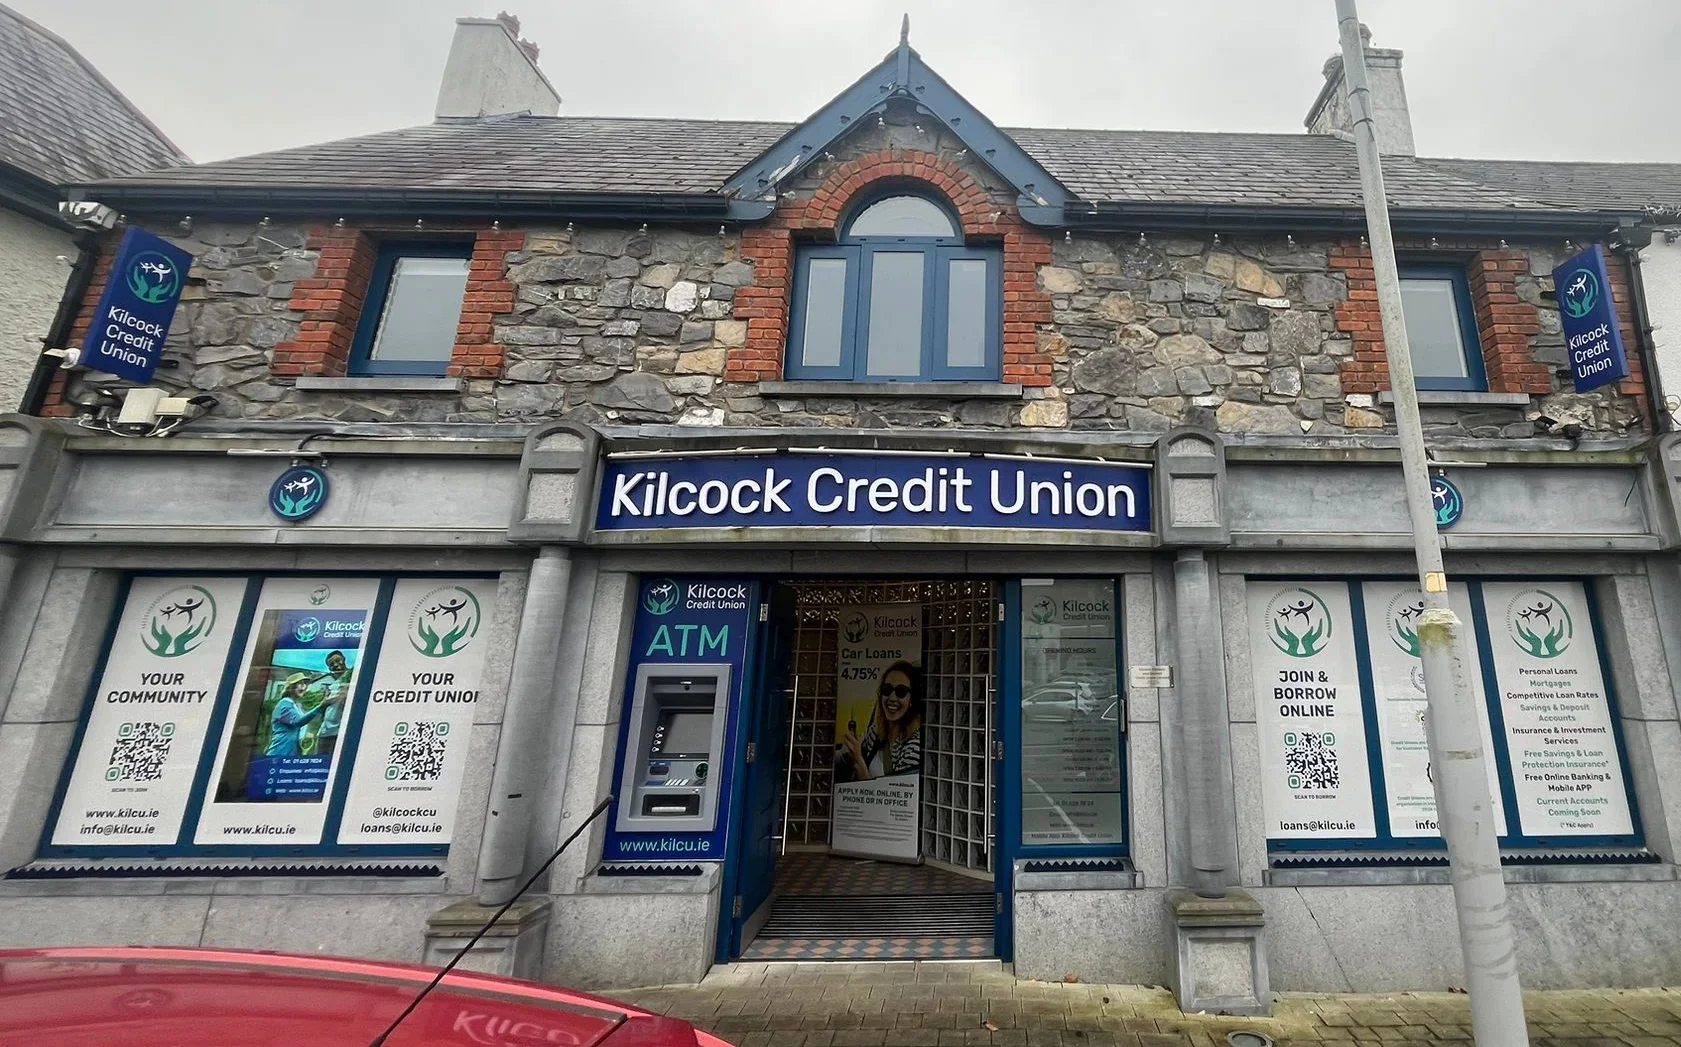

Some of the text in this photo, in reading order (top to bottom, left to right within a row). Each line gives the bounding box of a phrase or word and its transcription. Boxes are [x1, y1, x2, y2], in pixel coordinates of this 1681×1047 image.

[108, 306, 163, 338] Kilcock
[106, 325, 154, 352] Credit
[1569, 323, 1609, 350] Kilcock
[101, 341, 147, 367] Union
[1574, 339, 1610, 363] Credit
[1578, 358, 1612, 378] Union
[610, 467, 1136, 518] Kilcock Credit Union
[687, 584, 746, 599] Kilcock
[686, 600, 746, 609] Credit Union
[1063, 600, 1109, 612] Kilcock
[873, 616, 918, 628] Kilcock
[1063, 613, 1111, 621] Credit Union
[324, 621, 366, 631] Kilcock
[645, 624, 729, 657] ATM
[841, 648, 902, 659] Car Loans
[141, 673, 184, 685] YOUR
[412, 673, 454, 685] YOUR
[1279, 671, 1328, 683] JOIN &
[1529, 680, 1572, 688] Mortgages
[107, 691, 208, 703] COMMUNITY
[373, 690, 432, 703] CREDIT
[1273, 688, 1337, 700] BORROW
[1506, 692, 1555, 700] Competitive
[1279, 705, 1335, 717] ONLINE
[1520, 704, 1551, 712] Savings
[1560, 704, 1590, 712] Deposit
[1538, 714, 1577, 722] Accounts
[1561, 726, 1607, 734] Investment
[1544, 737, 1579, 745] Services
[1543, 750, 1575, 758] Savings
[1544, 773, 1570, 781] Online
[1571, 773, 1604, 782] Banking
[838, 787, 859, 795] APPLY
[1548, 784, 1592, 792] Mobile APP
[842, 796, 865, 804] PHONE
[884, 799, 908, 807] OFFICE
[1536, 797, 1609, 805] Current Accounts
[86, 808, 159, 818] www.kilcu.ie
[372, 807, 437, 818] @kilcockcu
[1548, 808, 1601, 817] Coming Soon
[80, 824, 155, 835] info@kilcu.ie
[223, 824, 296, 834] www.kilcu.ie
[361, 823, 442, 834] loans@kilcu.ie
[1280, 820, 1356, 831] loans@kilcu.ie
[620, 838, 710, 852] www.kilcu.ie
